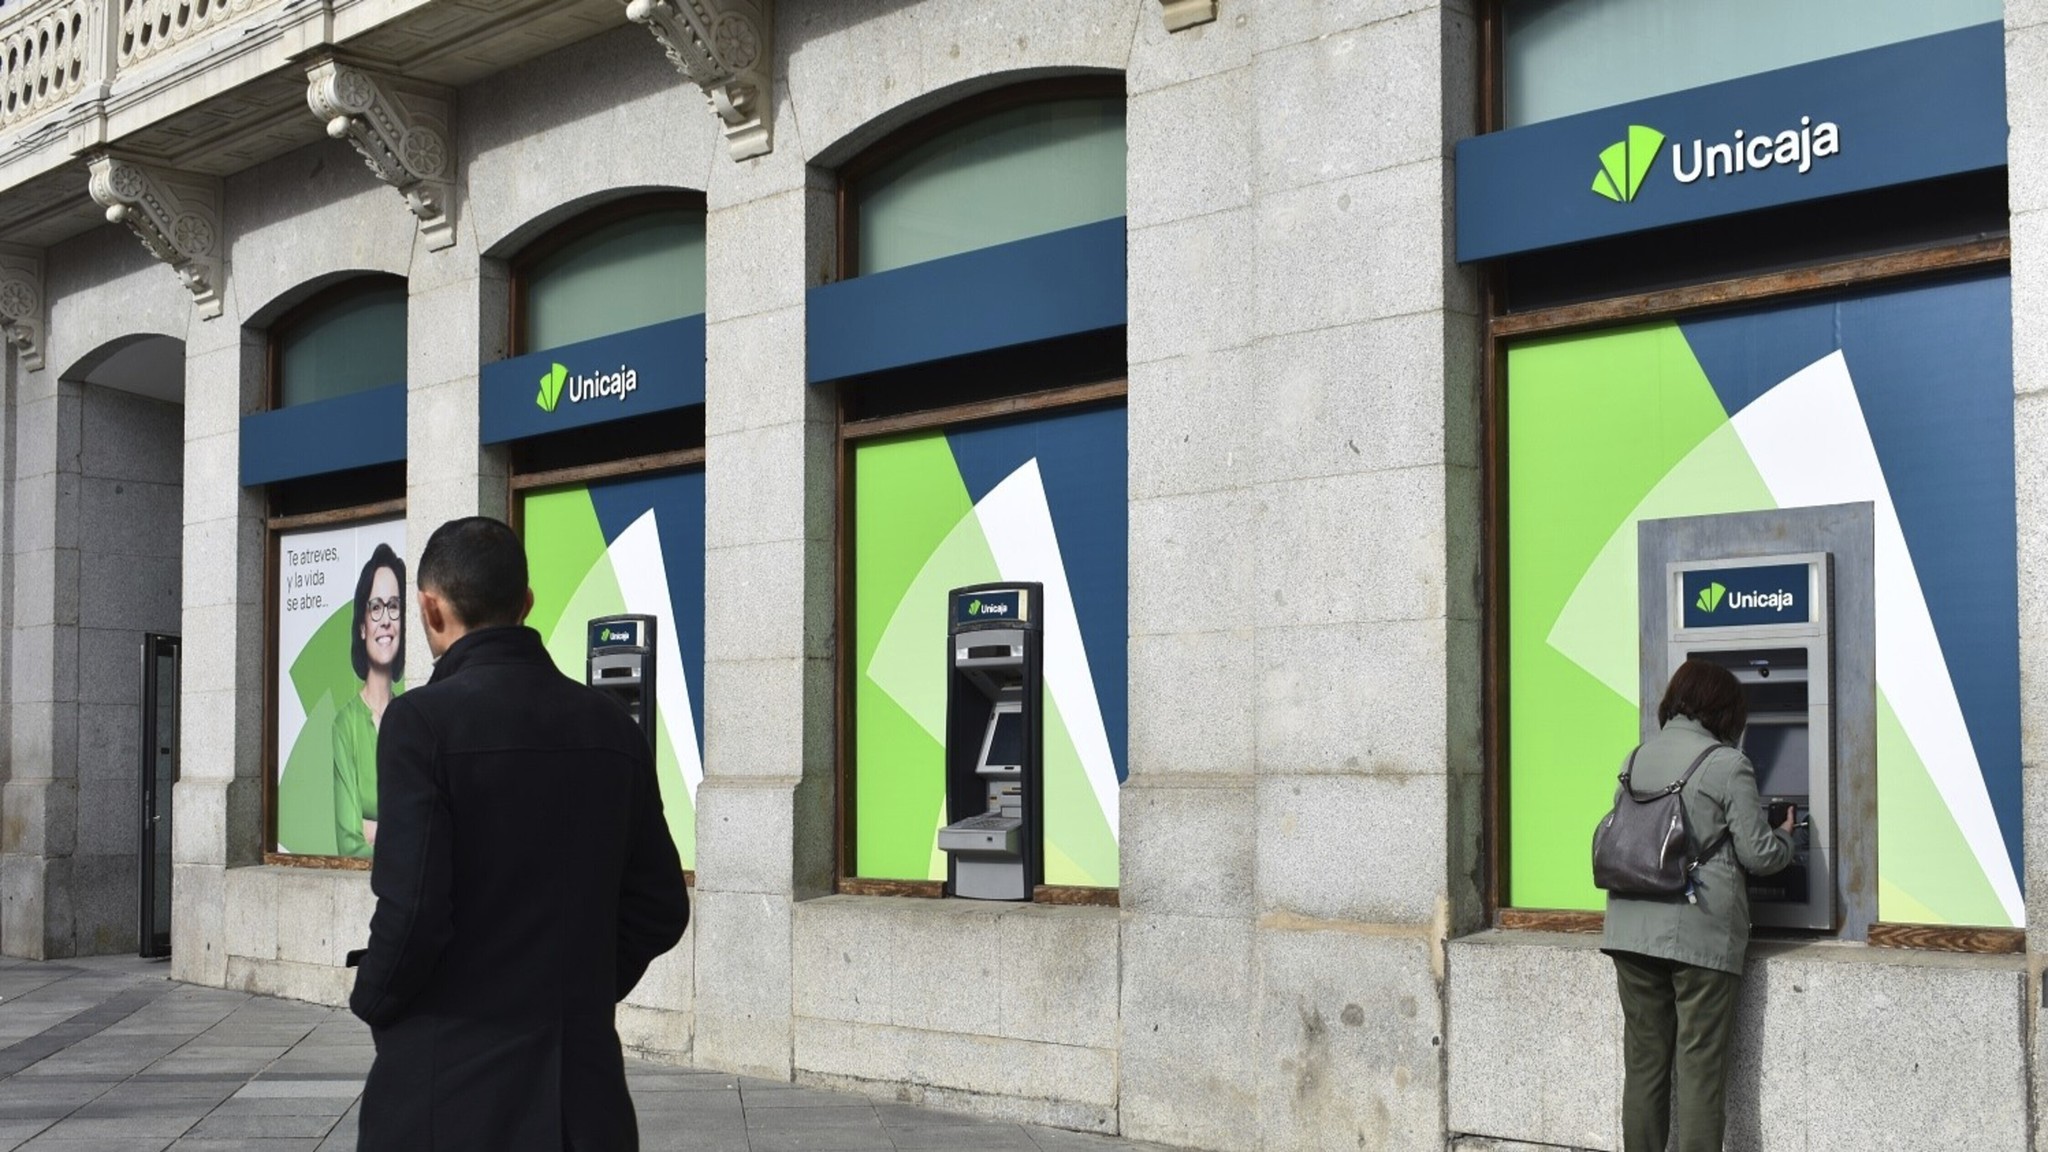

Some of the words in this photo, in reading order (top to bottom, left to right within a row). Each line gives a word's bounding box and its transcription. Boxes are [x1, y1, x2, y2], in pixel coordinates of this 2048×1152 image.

[1672, 115, 1840, 183] Unicaja
[569, 364, 637, 403] Unicaja
[287, 550, 299, 566] Te
[300, 547, 340, 565] atreves,
[287, 576, 294, 593] y
[294, 571, 303, 588] la
[304, 570, 325, 586] vida
[286, 599, 299, 611] se
[300, 594, 329, 610] abre...
[981, 603, 1008, 615] Unicaja
[1728, 589, 1793, 612] Unicaja
